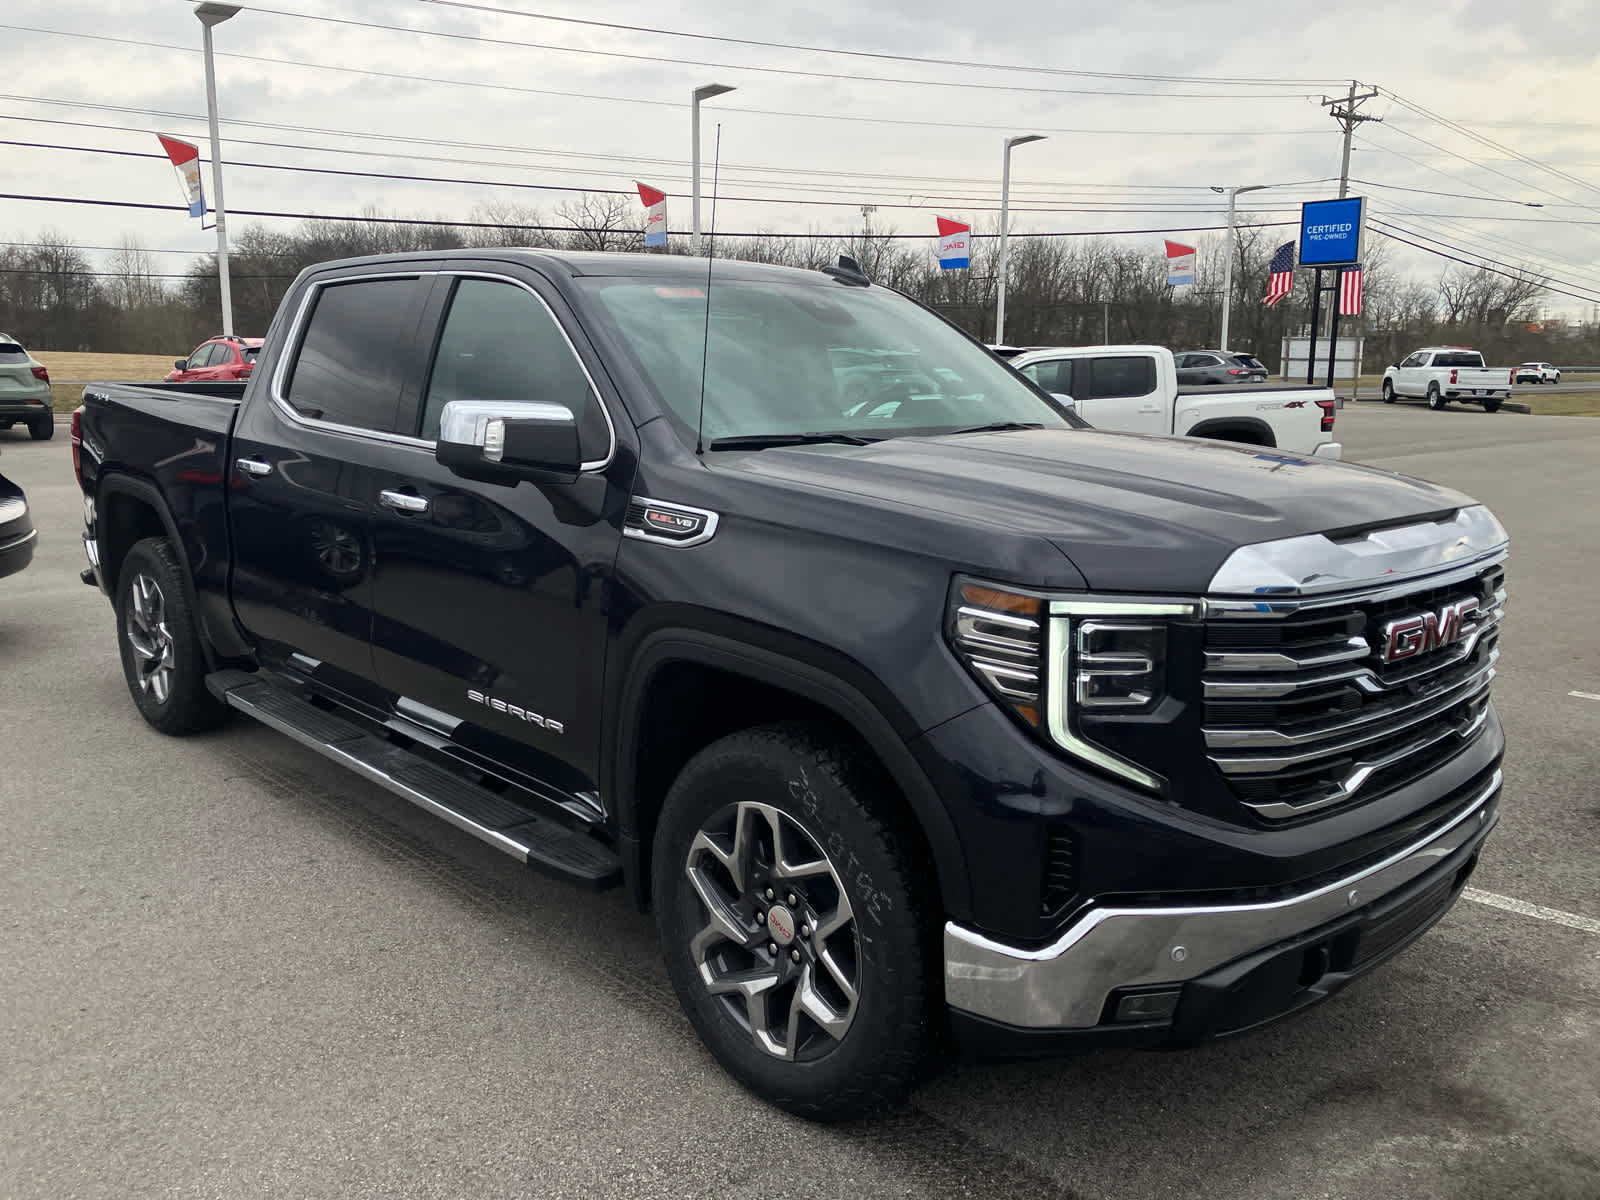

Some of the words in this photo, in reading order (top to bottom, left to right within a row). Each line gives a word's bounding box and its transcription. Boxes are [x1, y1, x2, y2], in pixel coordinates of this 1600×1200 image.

[1306, 223, 1352, 234] CERTIFIED
[675, 517, 693, 528] V8
[1383, 596, 1480, 664] GMC
[467, 689, 564, 734] SIERRA
[769, 911, 792, 939] GMC
